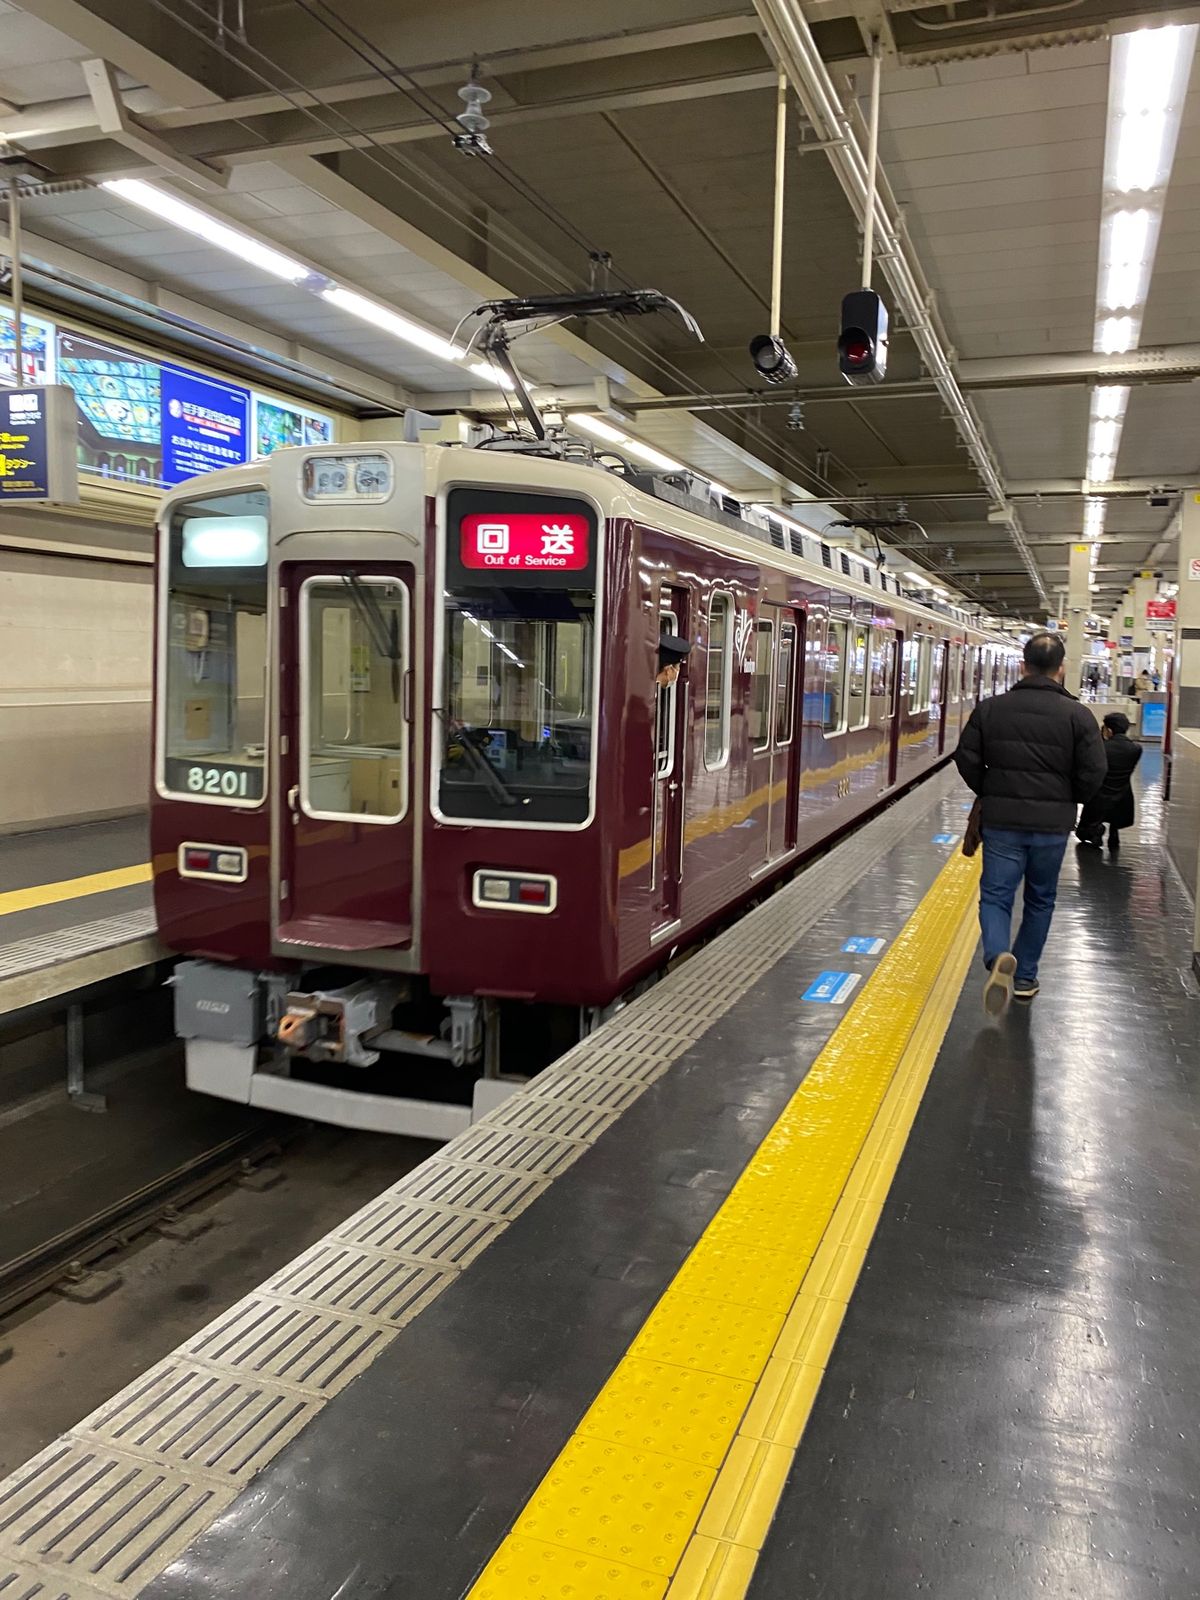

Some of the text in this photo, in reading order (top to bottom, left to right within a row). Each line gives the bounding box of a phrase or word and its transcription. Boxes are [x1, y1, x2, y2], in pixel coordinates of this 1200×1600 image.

[477, 524, 574, 555] 回送
[485, 554, 566, 566] Out of Service
[188, 767, 247, 796] 8201
